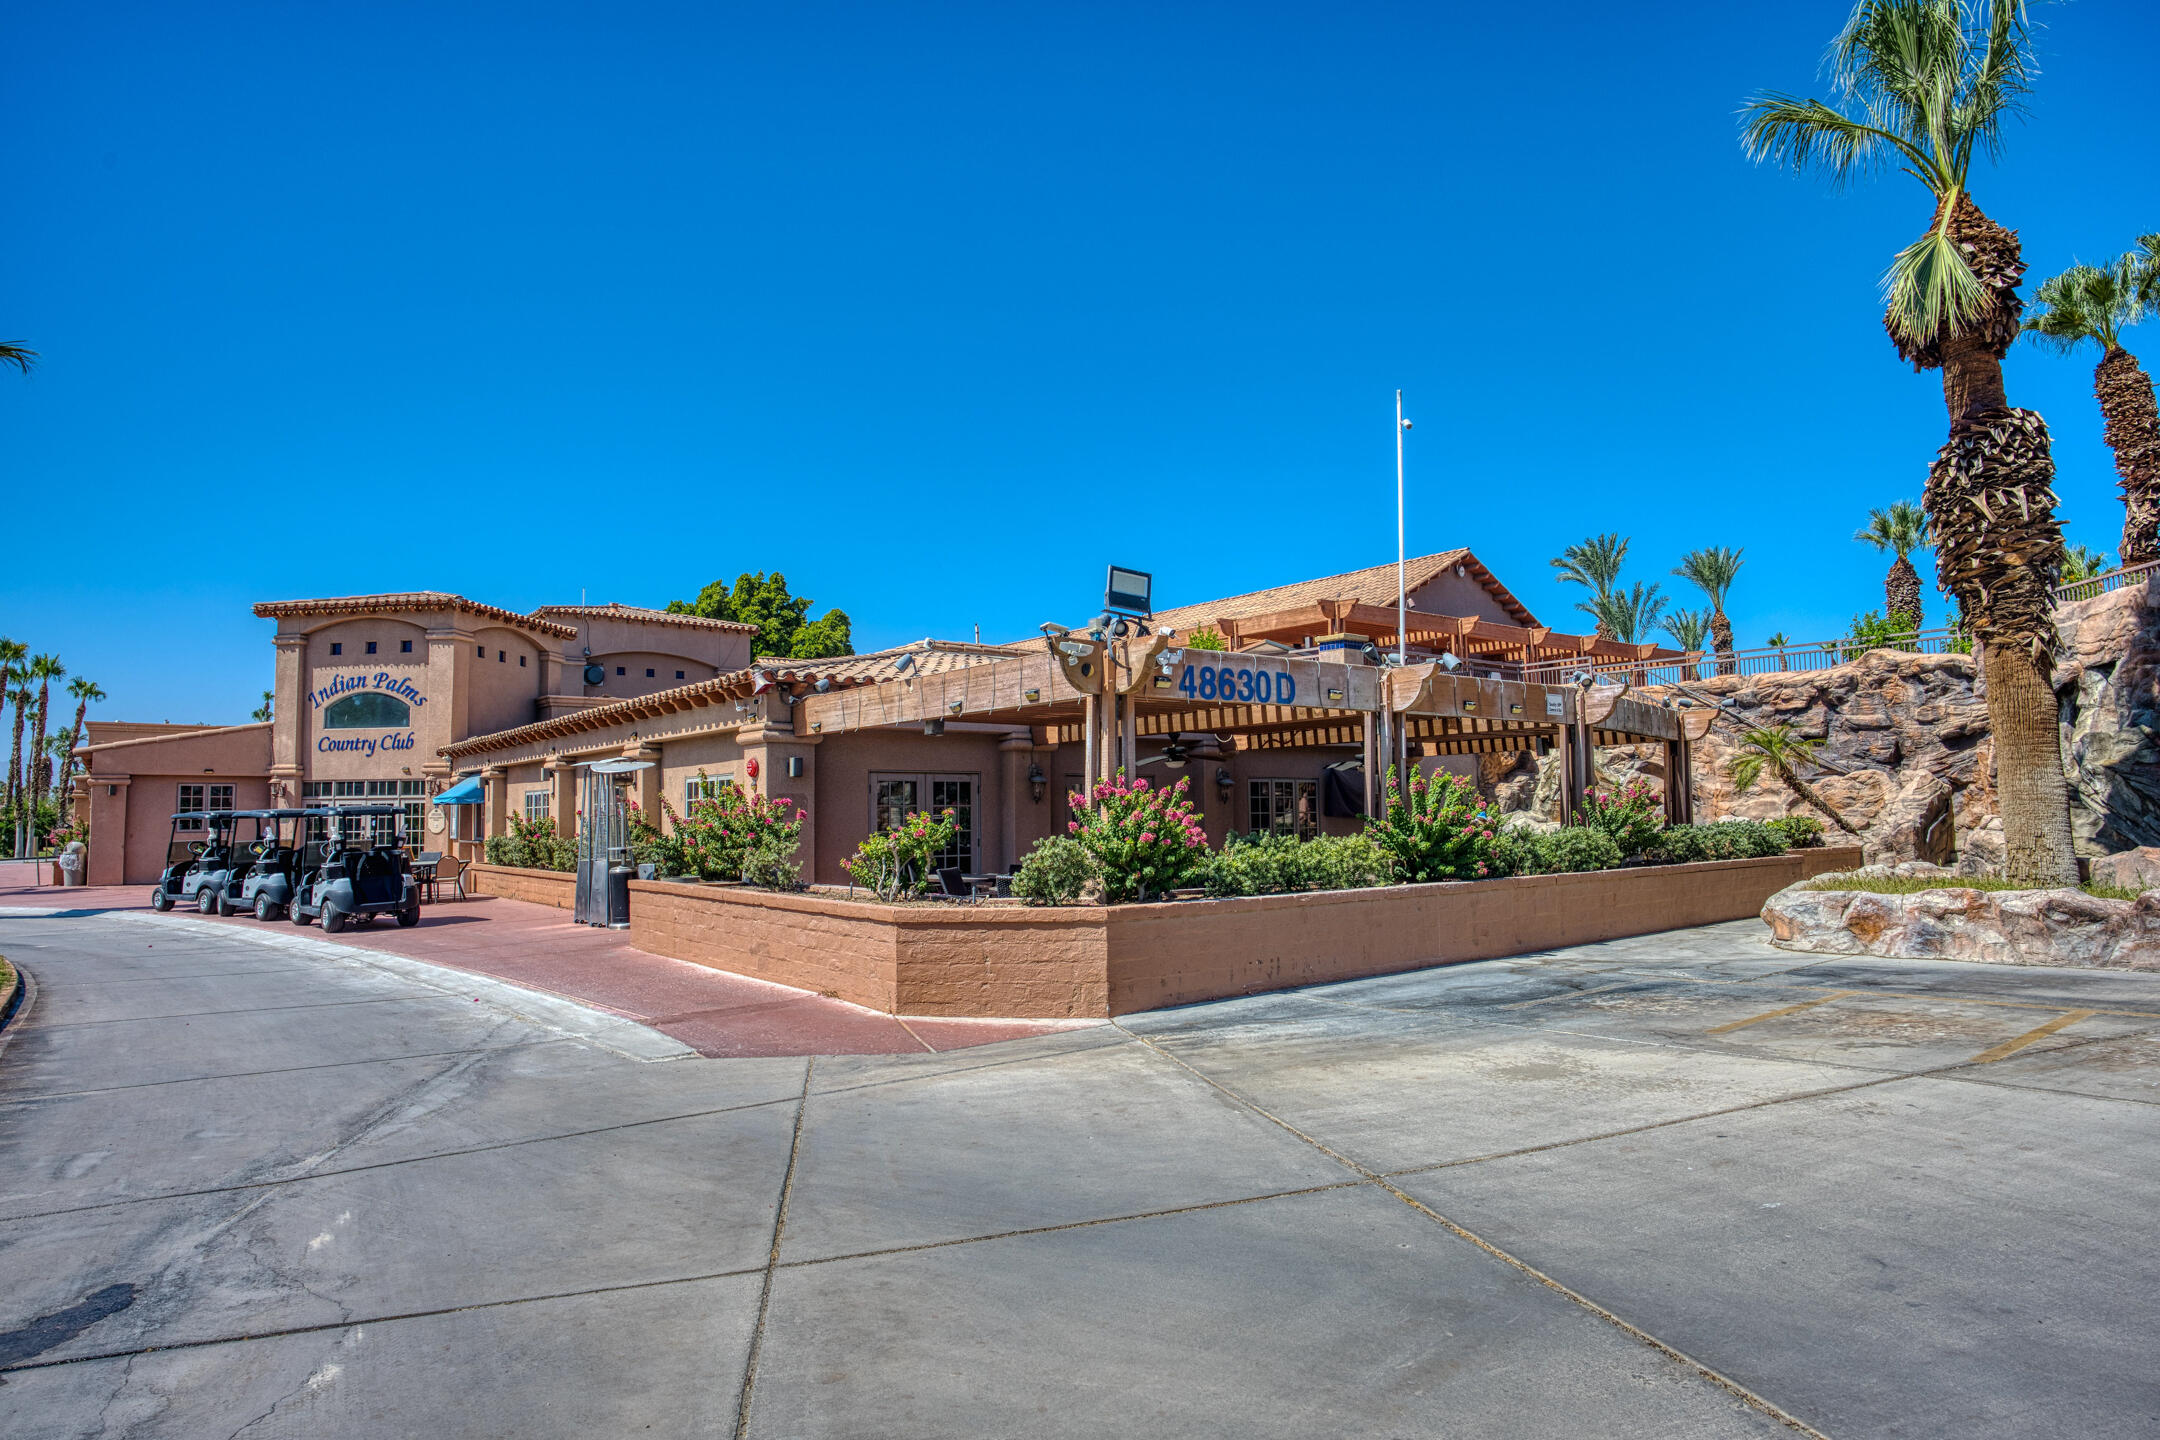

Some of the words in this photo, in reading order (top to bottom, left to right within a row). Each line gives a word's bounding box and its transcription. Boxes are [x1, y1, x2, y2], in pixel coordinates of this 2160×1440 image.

[308, 674, 368, 709] Indian
[372, 672, 428, 706] Palms
[318, 736, 377, 757] Country
[380, 731, 415, 751] Club
